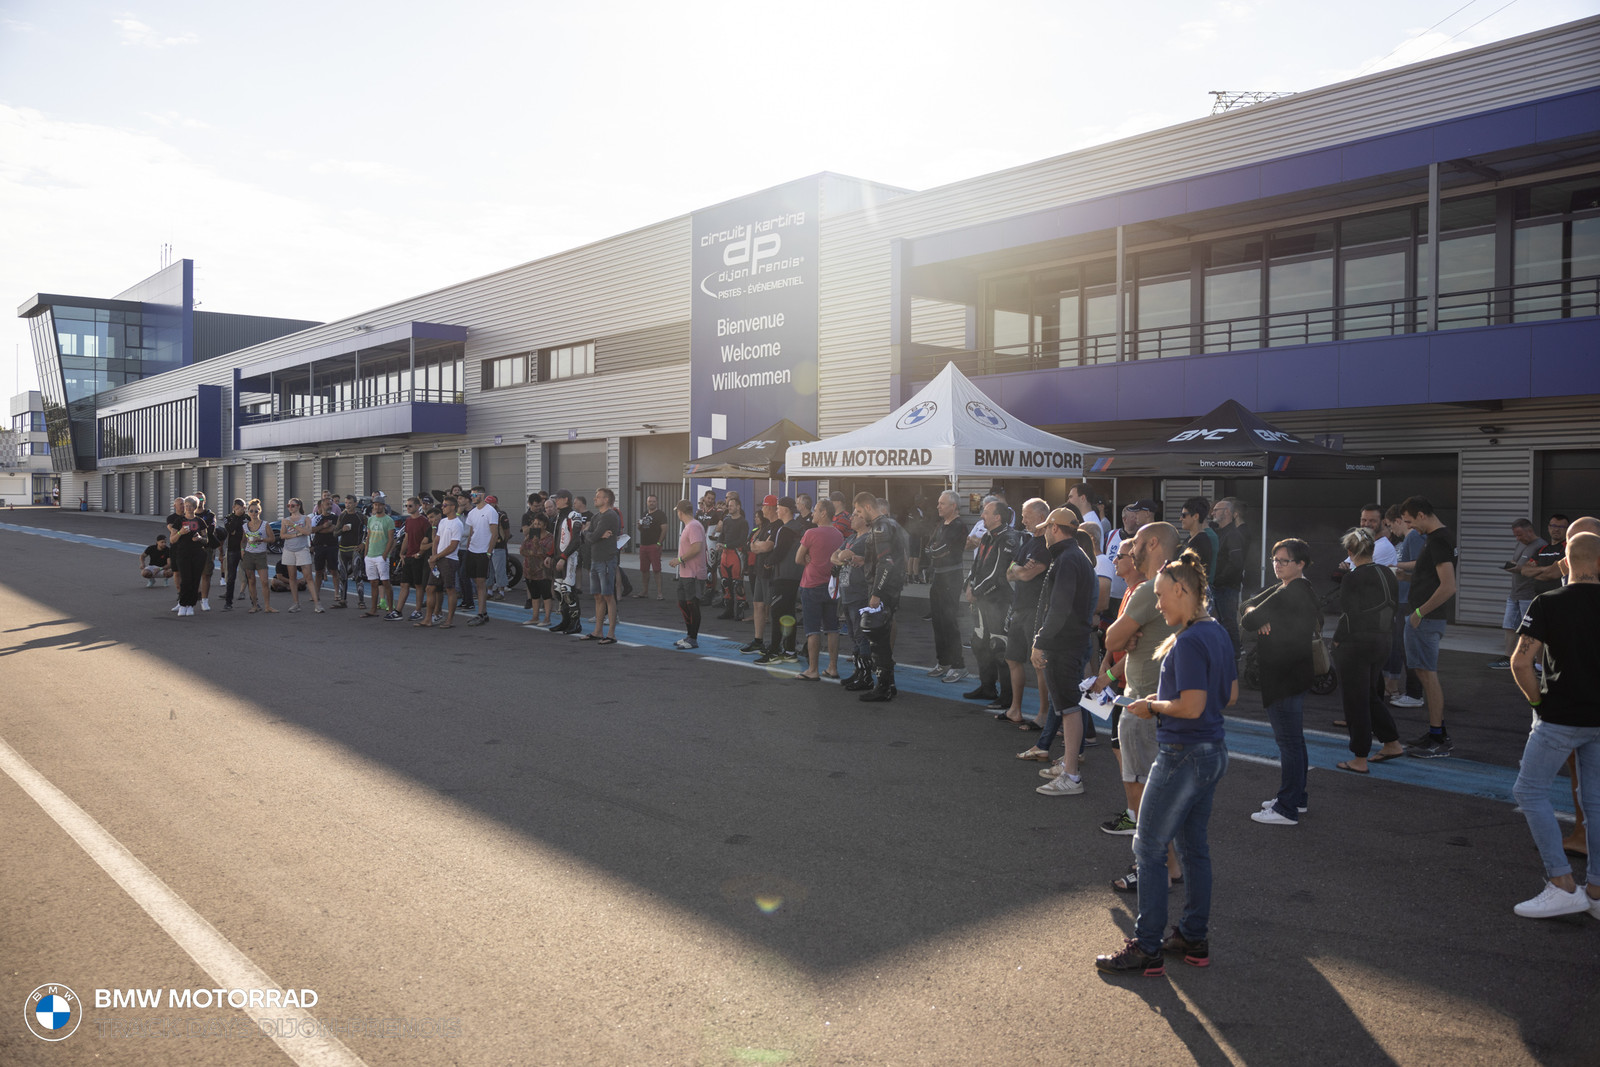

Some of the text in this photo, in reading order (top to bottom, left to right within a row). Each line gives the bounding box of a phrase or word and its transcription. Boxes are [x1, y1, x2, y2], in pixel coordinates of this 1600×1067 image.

[701, 211, 805, 247] circuit karting
[718, 268, 749, 282] dijon
[718, 287, 742, 299] PISTES
[717, 312, 785, 336] Bienvenue
[720, 341, 781, 363] Welcome
[712, 369, 791, 391] Willkommen
[1167, 428, 1239, 443] BMC
[1253, 429, 1300, 443] BMC
[1321, 438, 1336, 449] 17
[802, 448, 932, 468] BMW MOTORRAD
[974, 448, 1082, 469] BMW MOTORR
[1199, 459, 1254, 468] bmc-moto.com
[1108, 544, 1118, 561] AYS
